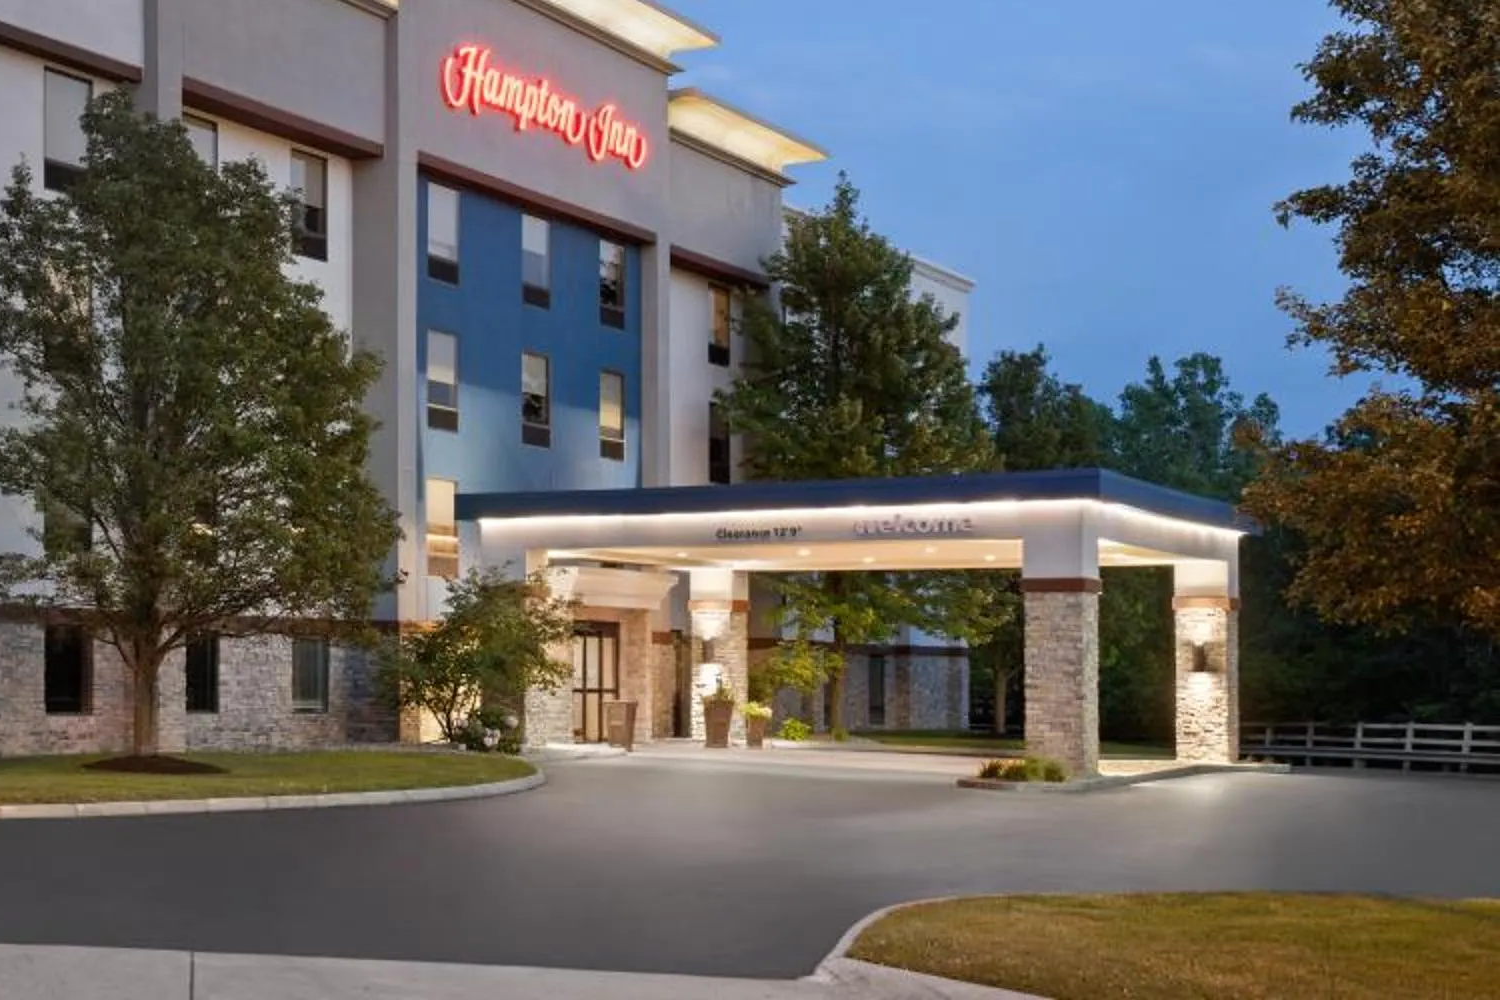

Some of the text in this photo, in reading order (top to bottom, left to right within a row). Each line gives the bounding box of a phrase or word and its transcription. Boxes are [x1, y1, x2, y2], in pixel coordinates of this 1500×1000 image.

[442, 45, 648, 169] Hampton Inn
[852, 513, 975, 535] welcome
